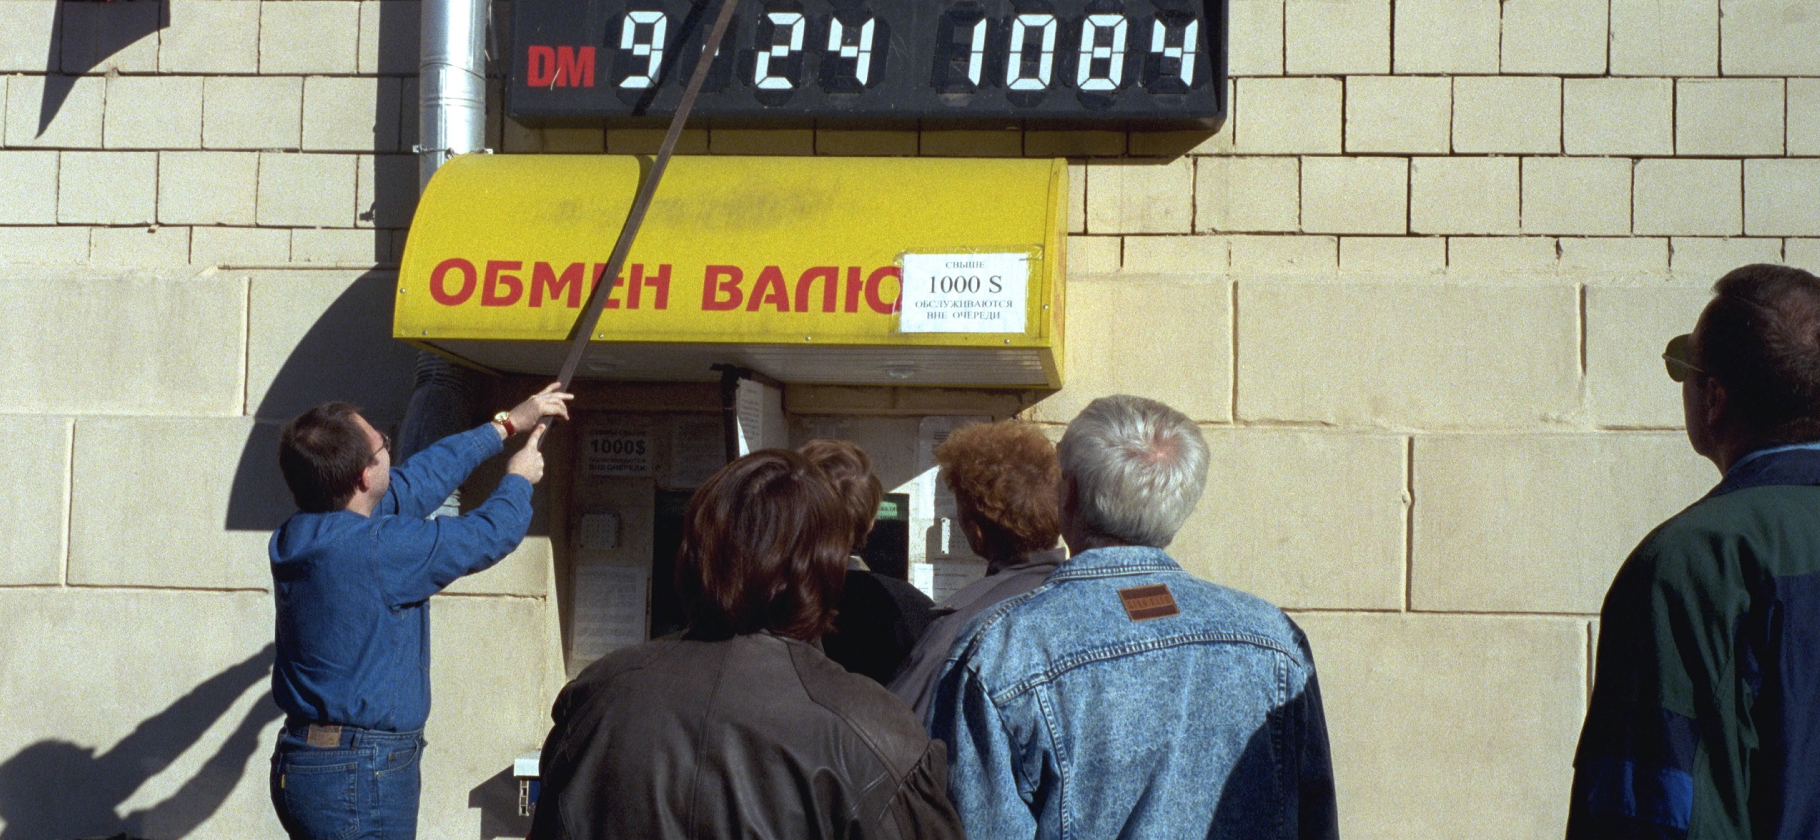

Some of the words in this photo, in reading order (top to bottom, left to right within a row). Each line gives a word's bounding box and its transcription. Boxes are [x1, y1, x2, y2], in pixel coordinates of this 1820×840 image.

[527, 45, 596, 88] DM
[968, 14, 1199, 91] 1084
[945, 261, 985, 269] СВЫШЕ
[429, 257, 672, 310] ОБМЕН
[929, 275, 981, 294] 1000
[914, 299, 1013, 309] ОБСЛУЖИВАЮТСЯ
[926, 311, 947, 320] ВНЕ
[952, 311, 1001, 321] ОЧЕРЕДИ
[591, 439, 646, 456] 1000$
